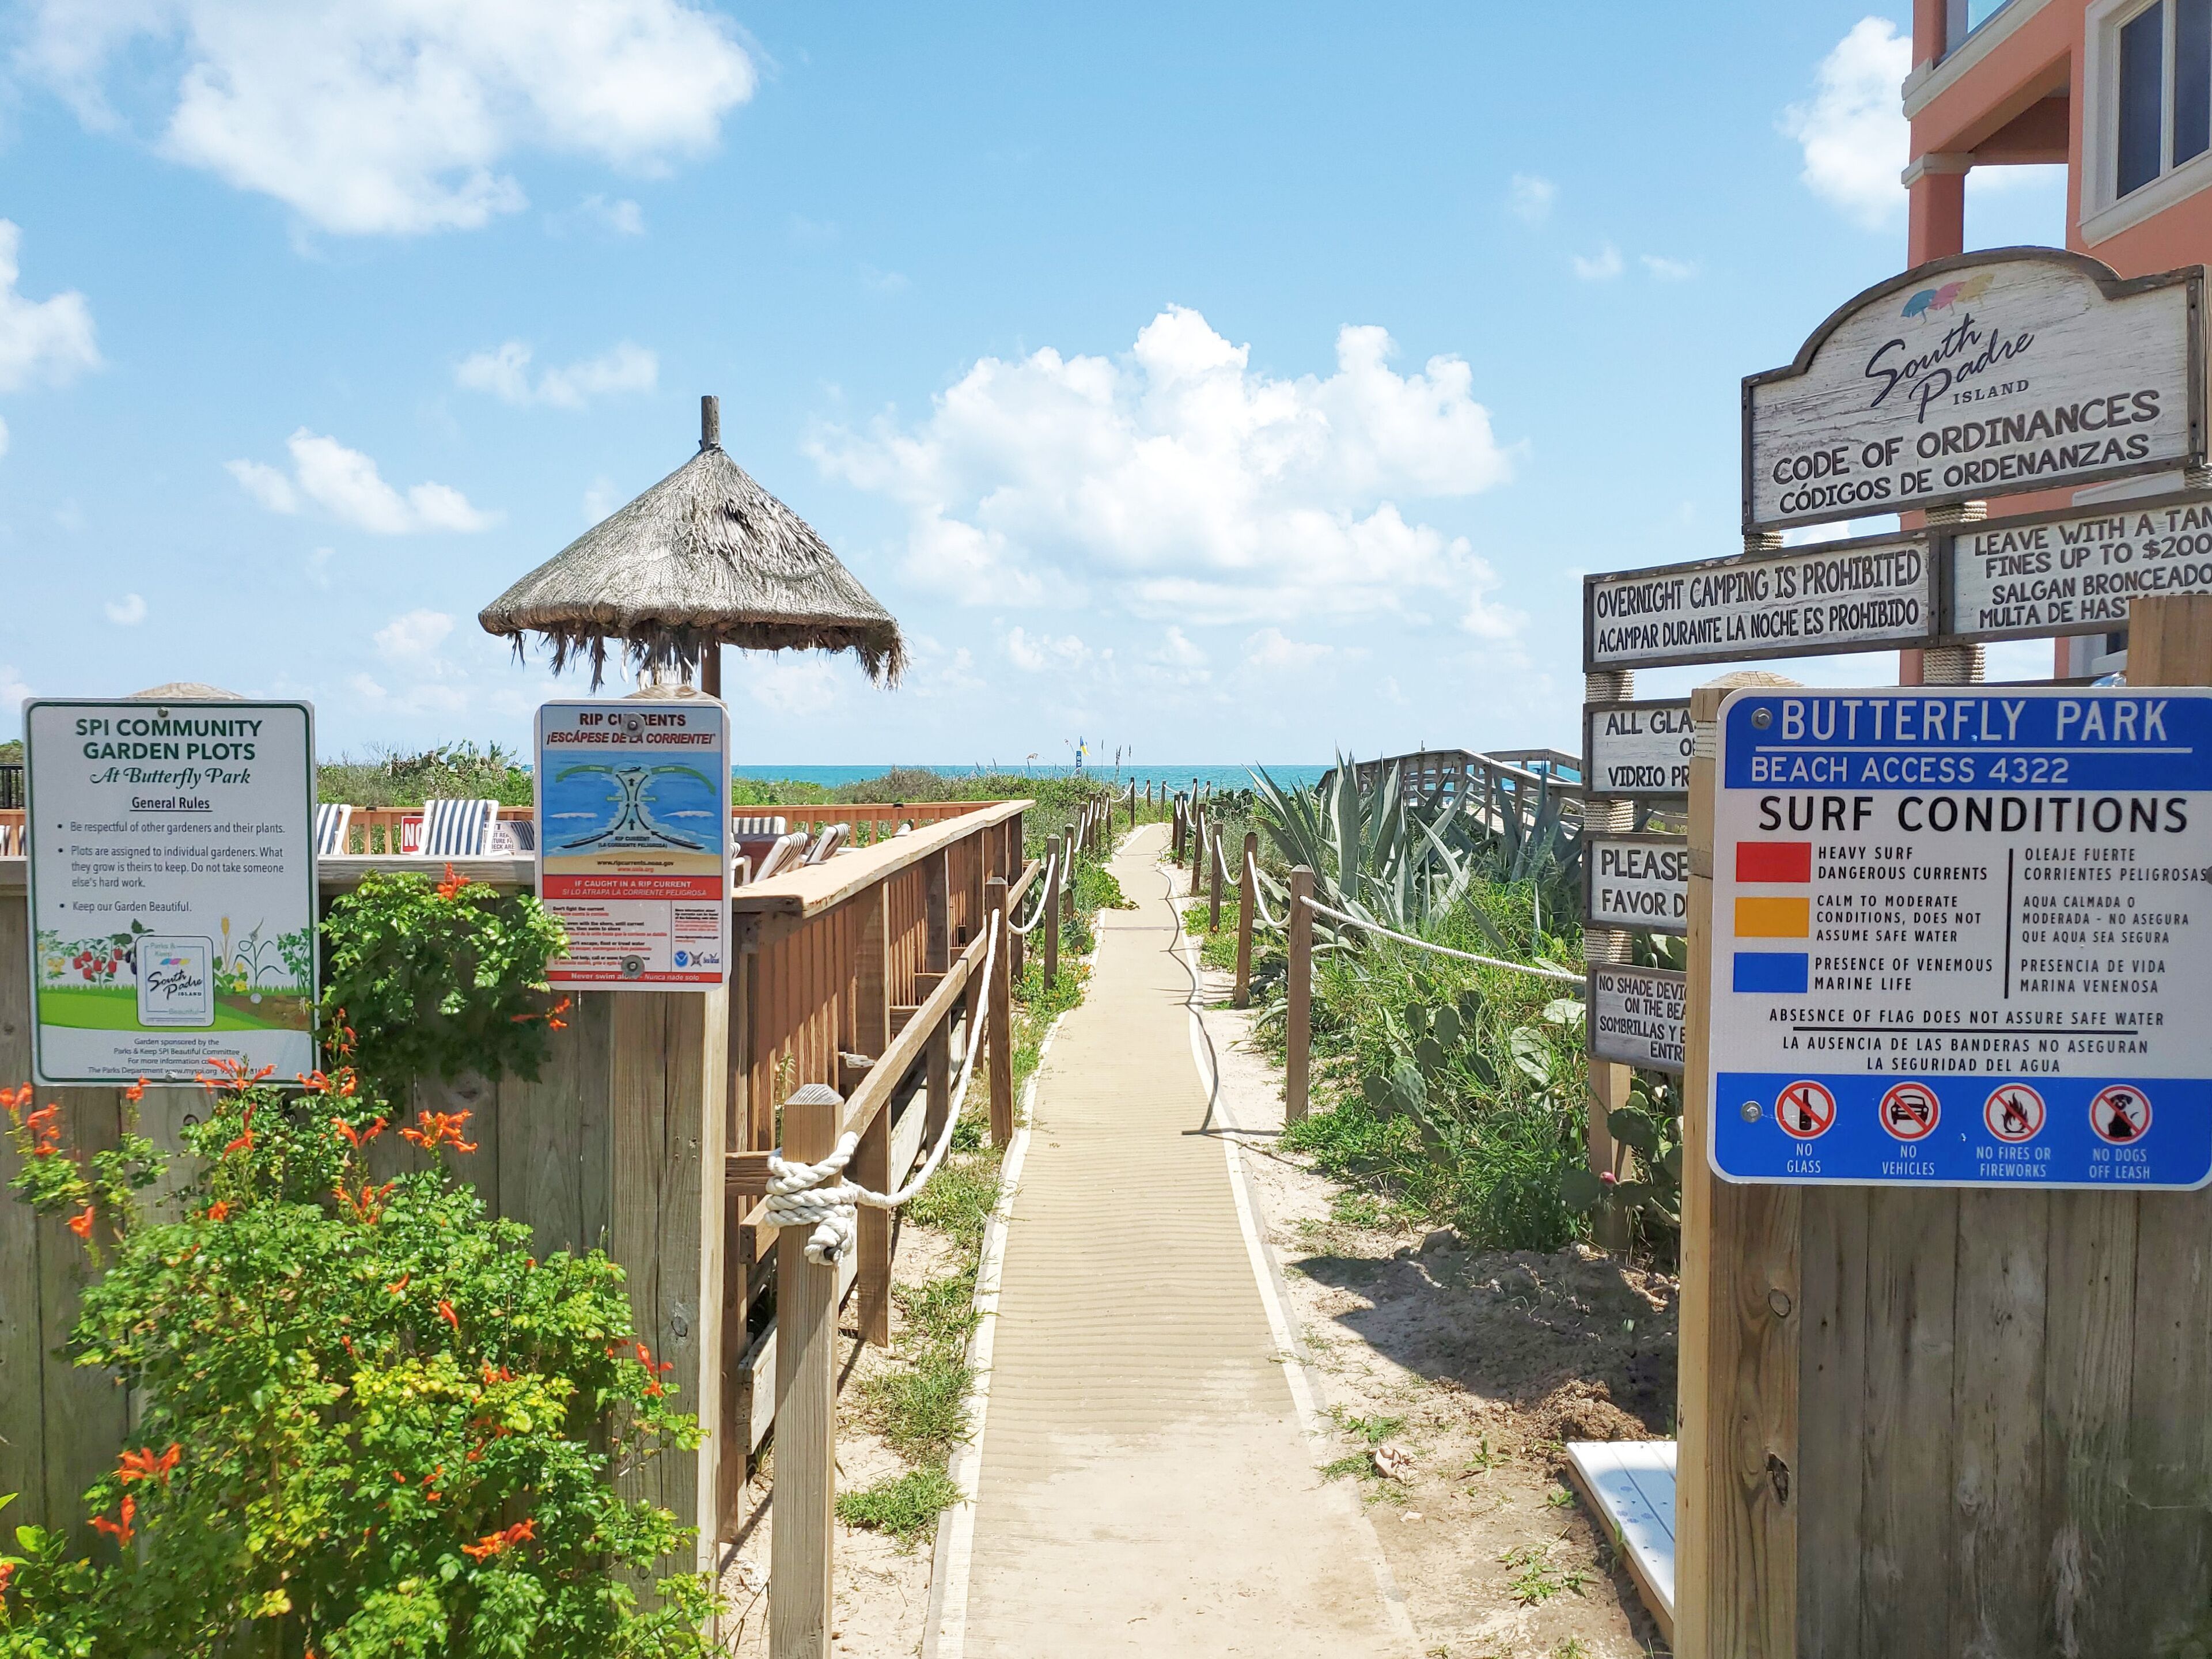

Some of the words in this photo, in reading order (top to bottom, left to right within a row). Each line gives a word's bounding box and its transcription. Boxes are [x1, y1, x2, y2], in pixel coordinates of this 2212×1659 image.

[1866, 313, 1982, 407] South
[1909, 328, 2035, 424] Padre
[1953, 380, 2029, 404] ISLAND
[1773, 446, 1850, 484] CODE
[1862, 437, 1903, 468] OF
[1917, 389, 2160, 459] ORDINANCES
[1780, 477, 1891, 513] CÓDIGOS
[1901, 468, 1933, 495] DE
[1944, 434, 2149, 487] ORDENANZAS
[1975, 527, 2048, 556] LEAVE
[2058, 517, 2124, 544] WITH
[2134, 514, 2155, 537] A
[1986, 551, 2051, 578] FINES
[2060, 547, 2090, 569] UP
[2100, 543, 2133, 565] TO
[1597, 579, 1684, 618] OVERNIGHT
[1690, 569, 1768, 608] CAMPING
[1775, 566, 1796, 599] IS
[1803, 549, 1921, 594] PROHIBITED
[1992, 578, 2075, 605] SALGAN
[1980, 605, 2041, 628] MULTA
[2048, 601, 2073, 623] DE
[1599, 624, 1659, 653] ACAMPAR
[1663, 617, 1722, 647] DURANTE
[1727, 615, 1746, 641] LA
[1751, 609, 1798, 638] NOCHE
[1804, 607, 1823, 635] ES
[1830, 598, 1919, 631] PROHIBIDO
[75, 719, 108, 736] SPI
[116, 719, 262, 737] COMMUNITY
[579, 713, 603, 726] RIP
[1605, 712, 1642, 736] ALL
[1781, 699, 2027, 741] BUTTERFLY
[2056, 700, 2168, 742] PARK
[611, 732, 627, 743] DE
[83, 742, 179, 760] GARDEN
[187, 743, 256, 760] PLOTS
[89, 767, 120, 783] At
[123, 767, 202, 789] Butterfly
[204, 767, 251, 784] Park
[1608, 766, 1665, 787] VIDRIO
[1752, 756, 1847, 782] BEACH
[1861, 757, 1975, 783] ACCESS
[1988, 757, 2069, 783] 4322
[132, 797, 175, 809] General
[179, 797, 210, 809] Rules
[1759, 796, 1874, 832] SURF
[1898, 796, 2188, 834] CONDITIONS
[70, 821, 82, 831] Be
[85, 821, 127, 834] respectful
[130, 821, 139, 832] of
[141, 822, 165, 832] other
[167, 822, 211, 835] gardeners
[214, 822, 230, 832] and
[233, 822, 254, 833] their
[256, 822, 285, 835] plants.
[71, 846, 93, 856] Plots
[111, 846, 150, 858] assigned
[153, 847, 162, 856] to
[164, 846, 208, 857] individual
[211, 847, 258, 859] gardeners.
[259, 846, 283, 857] What
[1819, 846, 1866, 859] HEAVY
[1875, 847, 1913, 859] SURF
[2025, 848, 2076, 861] OLEAJE
[2084, 849, 2136, 861] FUERTE
[71, 861, 90, 874] they
[93, 864, 115, 874] grow
[118, 862, 124, 872] is
[127, 861, 151, 872] theirs
[154, 863, 162, 872] to
[165, 862, 189, 874] keep.
[191, 862, 203, 872] Do
[206, 863, 220, 872] not
[222, 862, 241, 872] take
[243, 865, 284, 873] someone
[1601, 849, 1688, 881] PLEASE
[1819, 866, 1906, 879] DANGEROUS
[1914, 867, 1987, 880] CURRENTS
[72, 877, 97, 887] else's
[99, 876, 119, 887] hard
[122, 876, 145, 887] work.
[2024, 868, 2112, 880] CORRIENTES
[2120, 868, 2207, 881] PELIGROSAS
[73, 901, 94, 913] Keep
[115, 901, 146, 911] Garden
[149, 901, 192, 911] Beautiful.
[1603, 889, 1666, 916] FAVOR
[1817, 895, 1853, 907] CALM
[1861, 895, 1876, 907] TO
[1885, 896, 1957, 907] MODERATE
[1817, 912, 1906, 925] CONDITIONS,
[1914, 912, 1947, 923] DOES
[1956, 913, 1980, 924] NOT
[1816, 930, 1869, 941] ASSUME
[1876, 930, 1907, 941] SAFE
[1915, 930, 1957, 942] WATER
[1815, 957, 1885, 970] PRESENCE
[1893, 959, 1909, 971] OF
[1917, 959, 1993, 971] VENEMOUS
[147, 969, 186, 991] South
[162, 975, 202, 1000] Padre
[1599, 975, 1613, 991] NO
[1617, 978, 1653, 997] SHADE
[1815, 978, 1872, 990] MARINE
[1881, 978, 1911, 990] LIFE
[1624, 997, 1639, 1014] ON
[1643, 999, 1663, 1018] THE
[1770, 1009, 1844, 1022] ABSESNCE
[1853, 1009, 1871, 1022] OF
[1880, 1010, 1914, 1022] FLAG
[1923, 1010, 1960, 1023] DOES
[1970, 1011, 1998, 1024] NOT
[2006, 1012, 2063, 1024] ASSURE
[2071, 1012, 2107, 1025] SAFE
[2116, 1012, 2164, 1025] WATER
[1600, 1015, 1665, 1040] SOMBRILLAS
[1669, 1025, 1677, 1041] Y
[1796, 1143, 1812, 1156] NO
[1900, 1145, 1916, 1158] NO
[1976, 1146, 1993, 1160] NO
[1999, 1147, 2029, 1160] FIRES
[2035, 1147, 2051, 1161] OR
[2093, 1148, 2109, 1161] NO
[2115, 1149, 2147, 1162] DOGS
[1787, 1160, 1821, 1173] GLASS
[1882, 1161, 1934, 1176] VEHICLES
[1980, 1163, 2046, 1177] FIREWORKS
[2089, 1165, 2110, 1179] OFF
[2115, 1165, 2150, 1179] LEASH
